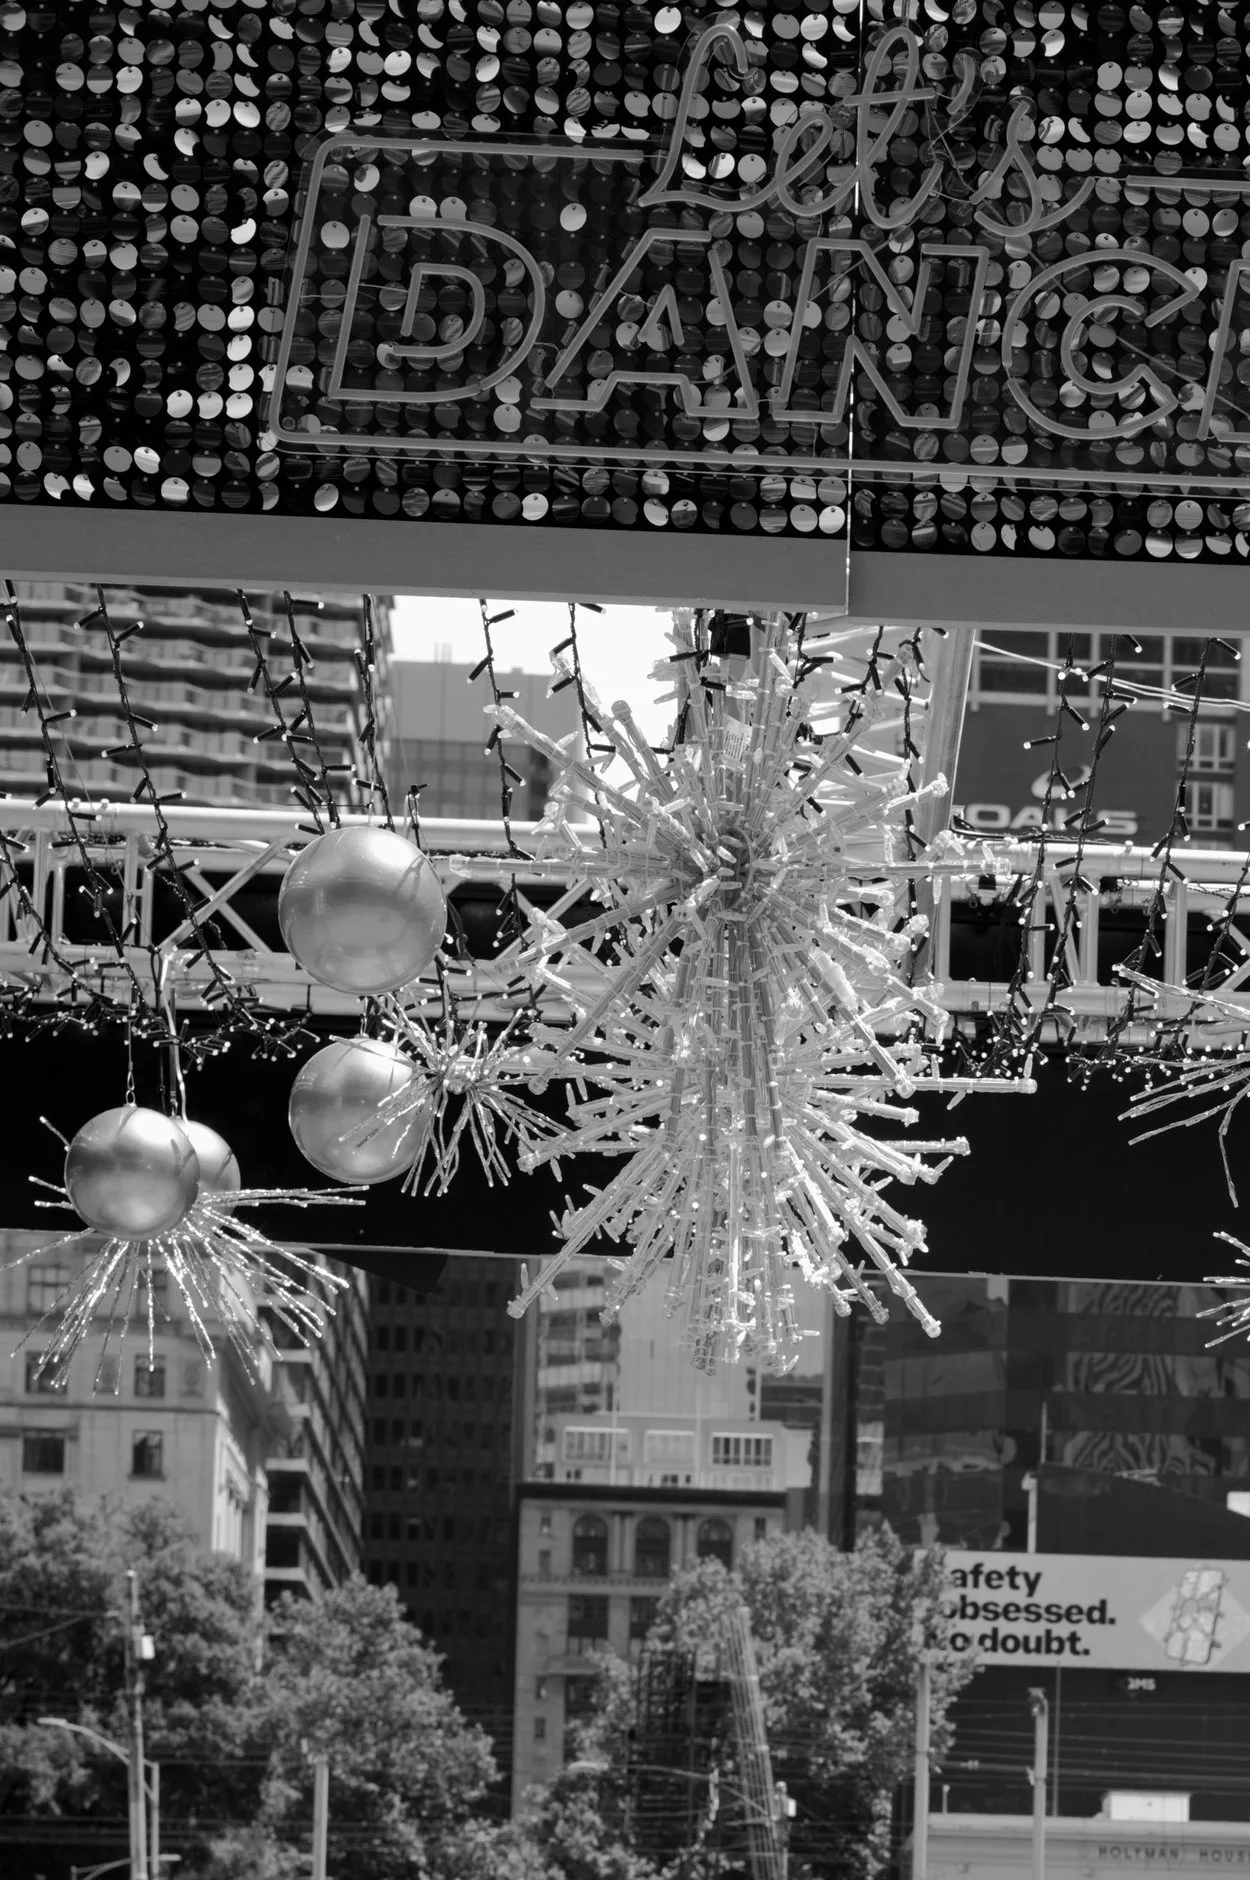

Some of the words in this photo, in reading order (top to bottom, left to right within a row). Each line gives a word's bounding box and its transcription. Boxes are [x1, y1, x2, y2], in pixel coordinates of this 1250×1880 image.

[638, 22, 1095, 238] Let's
[948, 1562, 1043, 1598] afety
[977, 1627, 1091, 1656] doubt.
[1098, 1846, 1179, 1860] HOLYMAN
